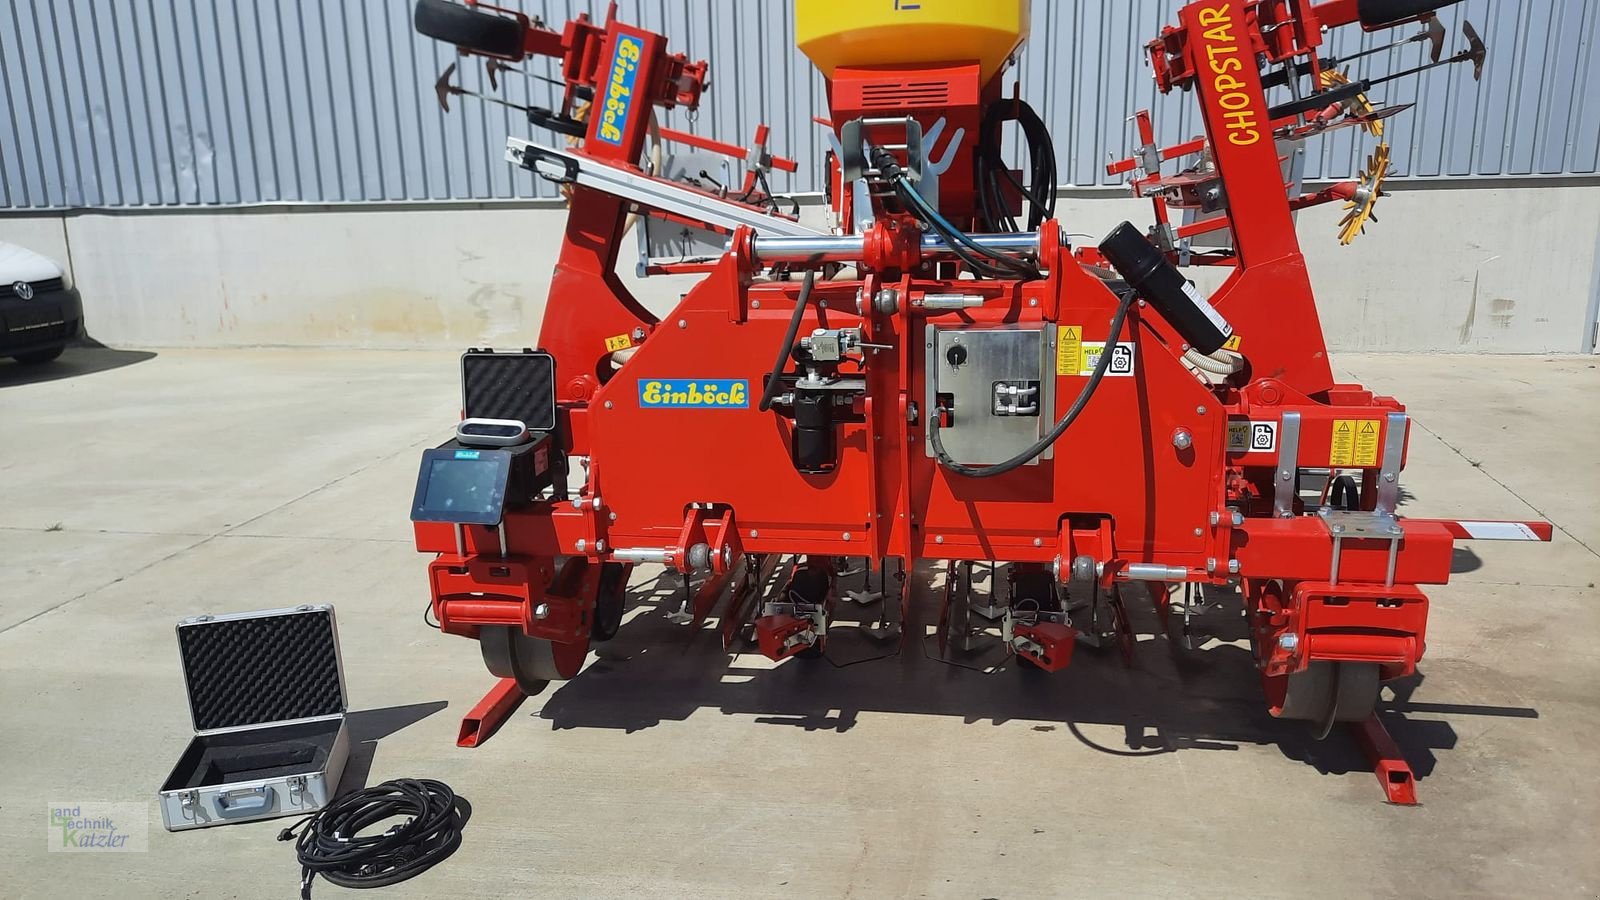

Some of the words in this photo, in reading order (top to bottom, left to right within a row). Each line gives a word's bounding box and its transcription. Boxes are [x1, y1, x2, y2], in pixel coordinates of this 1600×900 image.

[600, 38, 640, 142] Einböck
[1199, 3, 1260, 145] CHOPSTAR
[642, 381, 745, 405] Einböck
